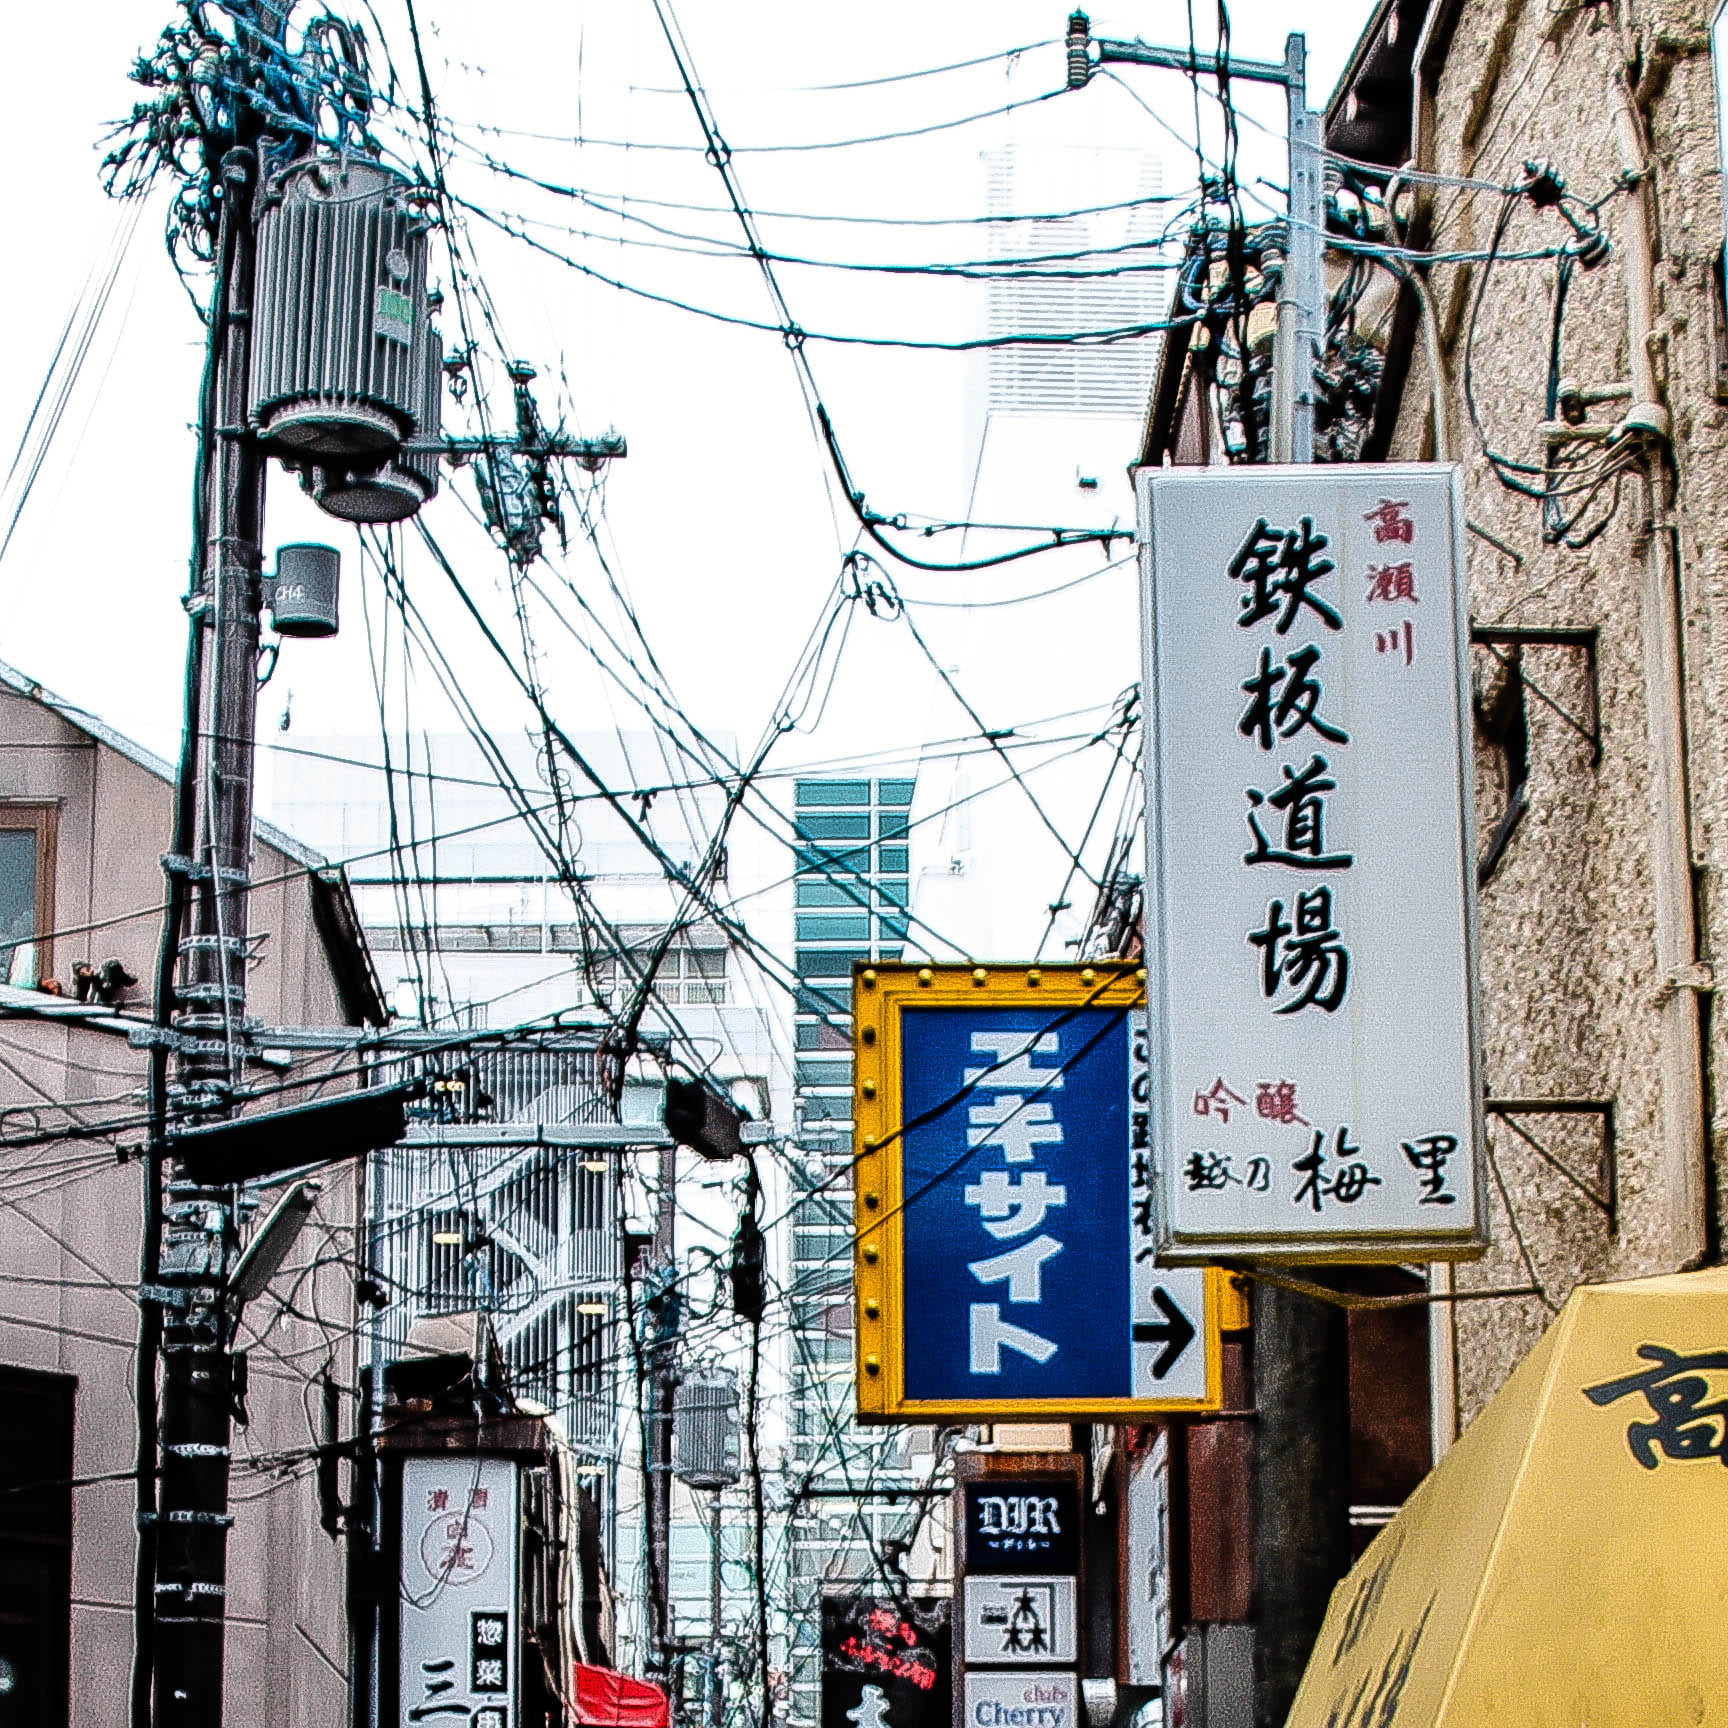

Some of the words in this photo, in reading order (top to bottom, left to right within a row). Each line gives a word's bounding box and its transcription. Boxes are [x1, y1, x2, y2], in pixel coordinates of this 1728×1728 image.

[1364, 496, 1421, 666] 高瀬川
[1228, 516, 1354, 1014] 鉄板道場
[964, 1030, 1067, 1376] エキサイト
